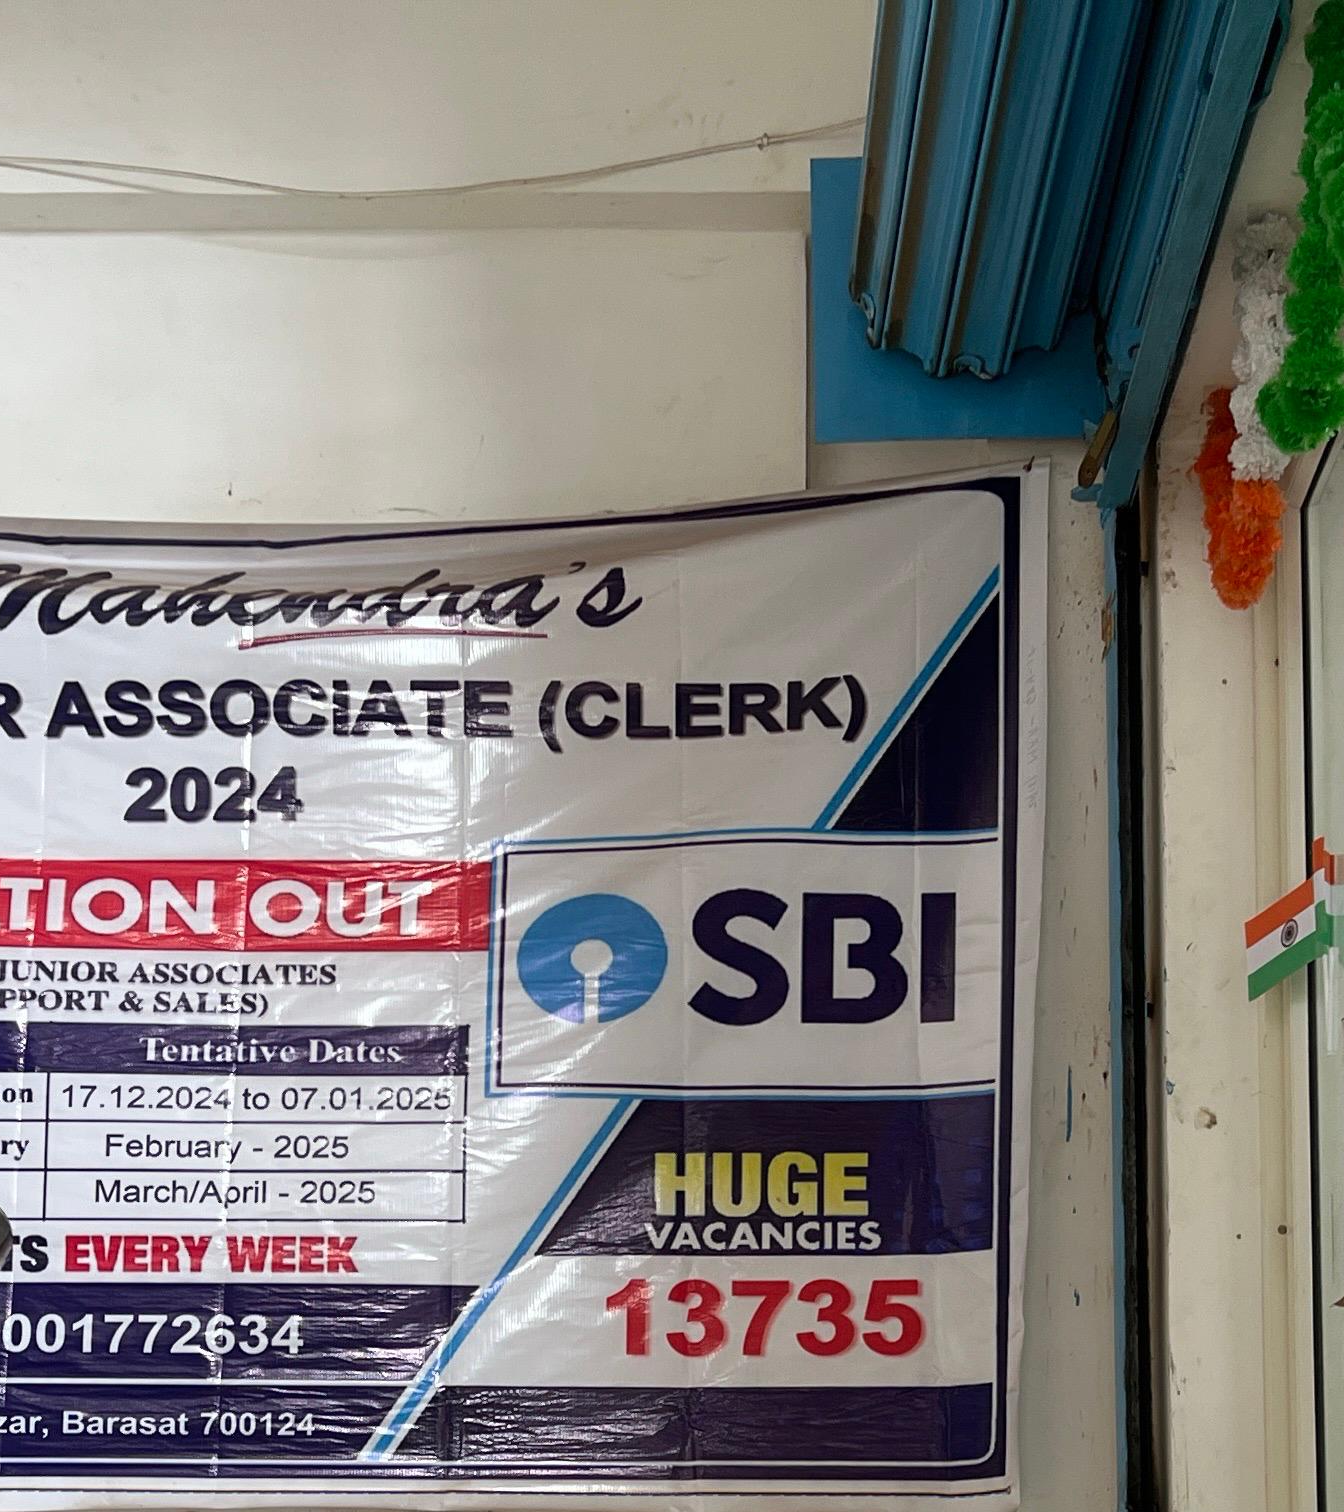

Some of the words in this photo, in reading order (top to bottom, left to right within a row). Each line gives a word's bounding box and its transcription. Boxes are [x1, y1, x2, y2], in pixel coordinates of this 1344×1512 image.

[44, 680, 515, 739] ASSOCIATE
[540, 674, 869, 753] (CLERK)
[123, 766, 305, 824] 2024
[248, 879, 434, 939] OUT
[129, 961, 338, 986] ASSOCIATES
[687, 888, 958, 1027] SBI
[118, 990, 145, 1013] &
[152, 991, 270, 1020] SALES)
[138, 1036, 297, 1064] Tentative
[308, 1038, 403, 1065] Dates
[60, 1084, 232, 1112] 17.12.2024
[241, 1086, 270, 1111] to
[280, 1085, 453, 1113] 07.01.2025
[104, 1133, 242, 1163] February
[274, 1135, 350, 1160] 2025
[94, 1179, 269, 1210] March/April
[300, 1180, 377, 1205] 2025
[652, 1151, 869, 1218] HUGE
[645, 1219, 883, 1252] VACANCIES
[64, 1234, 212, 1274] EVERY
[227, 1234, 361, 1275] WEEK
[605, 1278, 925, 1358] 13735
[62, 1410, 189, 1437] Barasat
[201, 1411, 316, 1438] 700124
